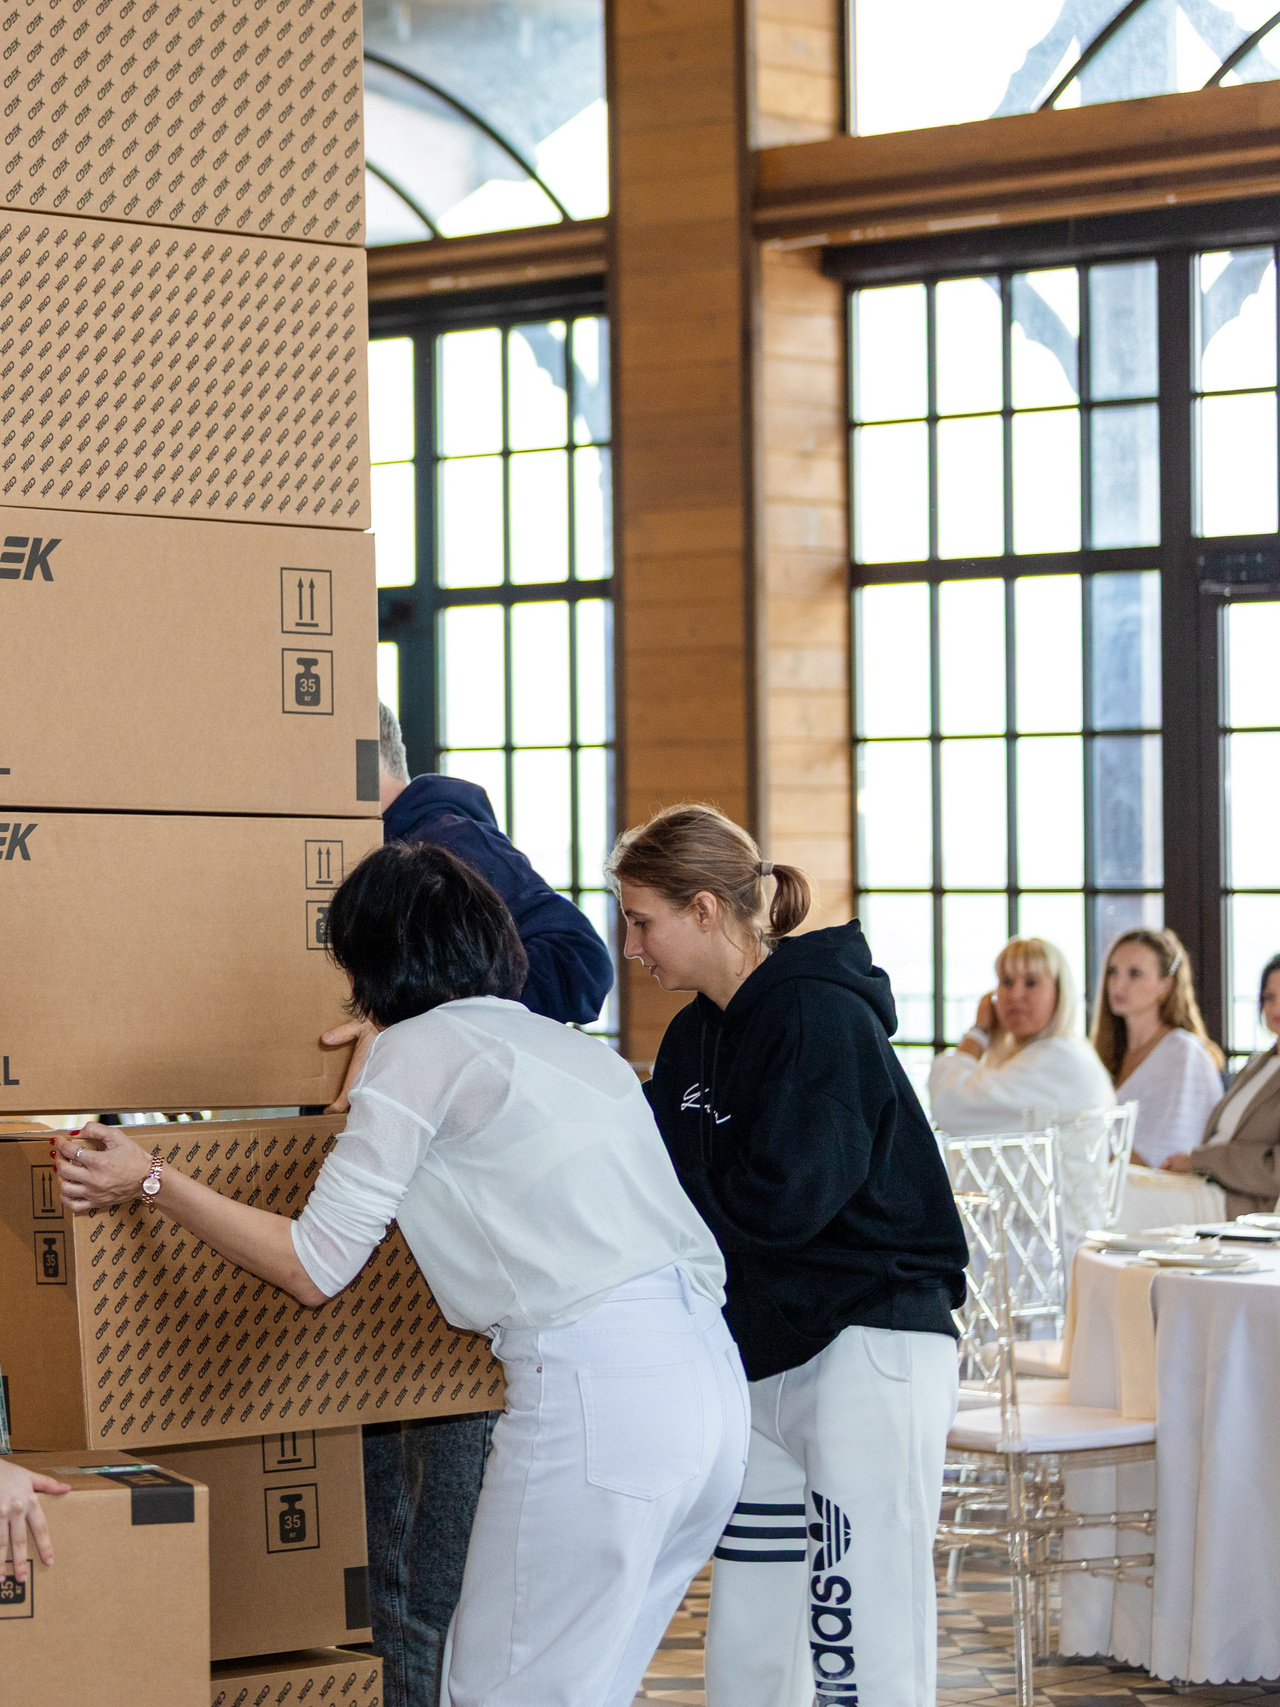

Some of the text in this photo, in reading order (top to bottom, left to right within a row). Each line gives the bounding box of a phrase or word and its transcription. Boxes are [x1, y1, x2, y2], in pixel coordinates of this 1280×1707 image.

[3, 9, 20, 31] CDEK
[233, 14, 248, 35] CDEK
[277, 21, 292, 41] CDEK
[120, 26, 136, 47] CDEK
[188, 35, 204, 56] CDEK
[233, 42, 249, 62] CDEK
[277, 49, 293, 68] CDEK
[121, 54, 137, 75] CDEK
[343, 56, 359, 77] CDEK
[4, 66, 21, 88] CDEK
[51, 72, 68, 94] CDEK
[97, 79, 114, 100] CDEK
[121, 82, 137, 103] CDEK
[4, 95, 21, 117] CDEK
[52, 101, 68, 123] CDEK
[301, 105, 316, 126] CDEK
[122, 110, 138, 131] CDEK
[5, 123, 22, 145] CDEK
[52, 129, 69, 151] CDEK
[99, 135, 115, 157] CDEK
[6, 152, 23, 174] CDEK
[99, 163, 116, 185] CDEK
[280, 157, 295, 178] CDEK
[169, 171, 185, 193] CDEK
[258, 182, 274, 203] CDEK
[129, 237, 142, 255] CDEK
[110, 258, 124, 275] CDEK
[55, 275, 69, 292] CDEK
[18, 294, 32, 312] CDEK
[168, 353, 181, 371] CDEK
[113, 371, 126, 388] CDEK
[95, 392, 108, 410] CDEK
[58, 411, 72, 430] CDEK
[21, 431, 35, 450] CDEK
[299, 678, 316, 693] 35
[186, 1141, 201, 1163] CDEK
[264, 1136, 278, 1157] CDEK
[283, 1134, 298, 1156] CDEK
[284, 1159, 299, 1180] CDEK
[90, 1221, 105, 1243] CDEK
[45, 1254, 56, 1268] 35
[112, 1244, 126, 1265] CDEK
[93, 1270, 108, 1291] CDEK
[133, 1266, 148, 1288] CDEK
[173, 1263, 187, 1285] CDEK
[114, 1292, 129, 1314] CDEK
[174, 1286, 189, 1309] CDEK
[213, 1283, 228, 1305] CDEK
[370, 1294, 384, 1316] CDEK
[155, 1312, 170, 1334] CDEK
[195, 1309, 210, 1331] CDEK
[254, 1304, 269, 1325] CDEK
[95, 1318, 110, 1340] CDEK
[116, 1317, 130, 1338] CDEK
[275, 1326, 289, 1348] CDEK
[313, 1322, 328, 1344] CDEK
[117, 1340, 132, 1362] CDEK
[157, 1337, 172, 1359] CDEK
[197, 1333, 211, 1355] CDEK
[334, 1344, 348, 1366] CDEK
[410, 1337, 425, 1358] CDEK
[218, 1355, 232, 1377] CDEK
[257, 1351, 271, 1373] CDEK
[276, 1349, 290, 1371] CDEK
[430, 1358, 444, 1379] CDEK
[449, 1356, 463, 1377] CDEK
[138, 1363, 153, 1385] CDEK
[297, 1372, 311, 1393] CDEK
[316, 1369, 331, 1391] CDEK
[355, 1365, 369, 1387] CDEK
[393, 1362, 407, 1383] CDEK
[140, 1387, 154, 1409] CDEK
[160, 1385, 175, 1407] CDEK
[179, 1383, 194, 1405] CDEK
[199, 1380, 214, 1403] CDEK
[239, 1377, 253, 1399] CDEK
[99, 1391, 114, 1413] CDEK
[120, 1389, 134, 1411] CDEK
[260, 1399, 274, 1421] CDEK
[299, 1395, 313, 1416] CDEK
[141, 1411, 156, 1433] CDEK
[181, 1407, 196, 1429] CDEK
[221, 1403, 235, 1425] CDEK
[284, 1515, 301, 1529] 35
[0, 1580, 14, 1599] 35
[297, 1679, 313, 1703] CDEK
[319, 1676, 335, 1700] CDEK
[340, 1673, 357, 1697] CDEK
